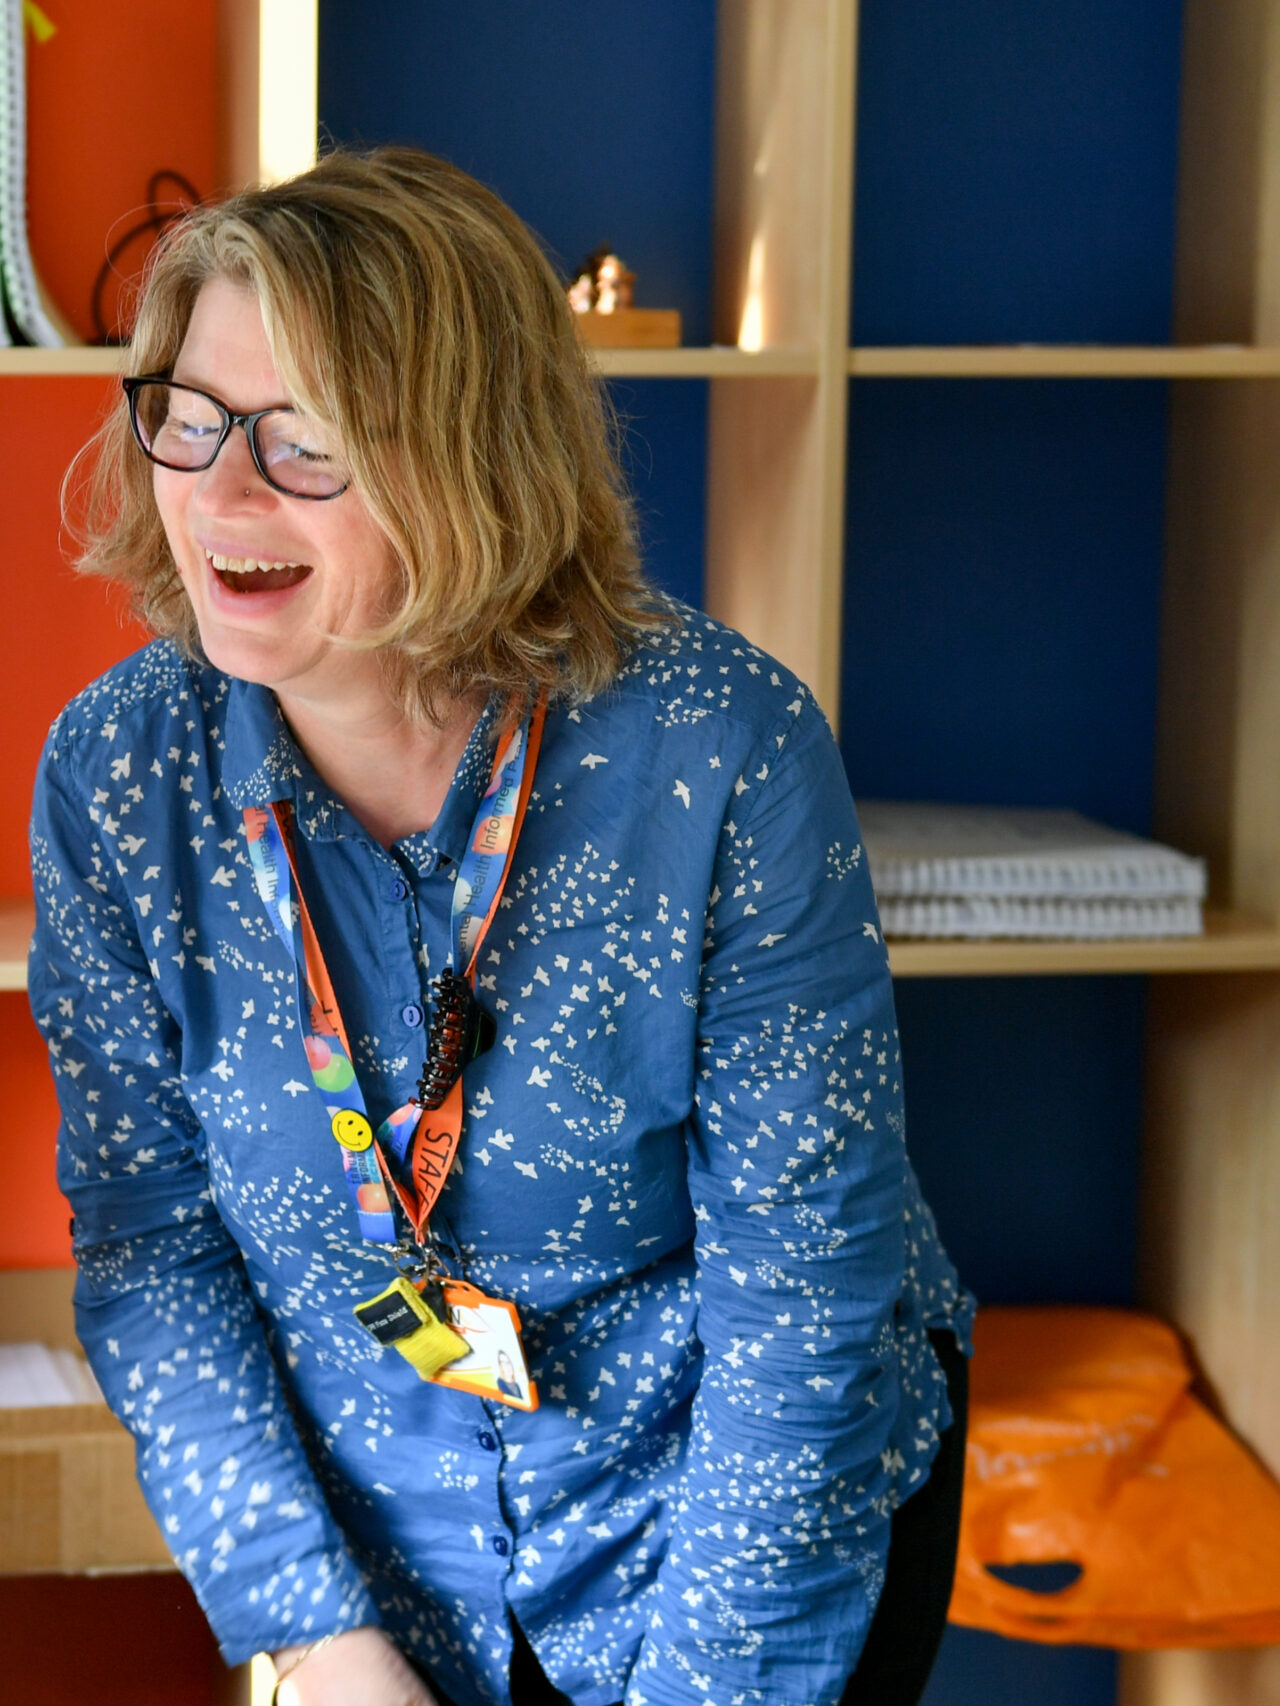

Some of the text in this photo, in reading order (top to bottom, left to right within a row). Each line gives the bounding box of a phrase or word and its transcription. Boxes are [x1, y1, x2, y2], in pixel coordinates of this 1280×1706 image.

[464, 853, 492, 906] Health
[480, 778, 514, 851] Informed
[347, 1150, 361, 1184] TRAUM
[418, 1128, 453, 1215] STAFF
